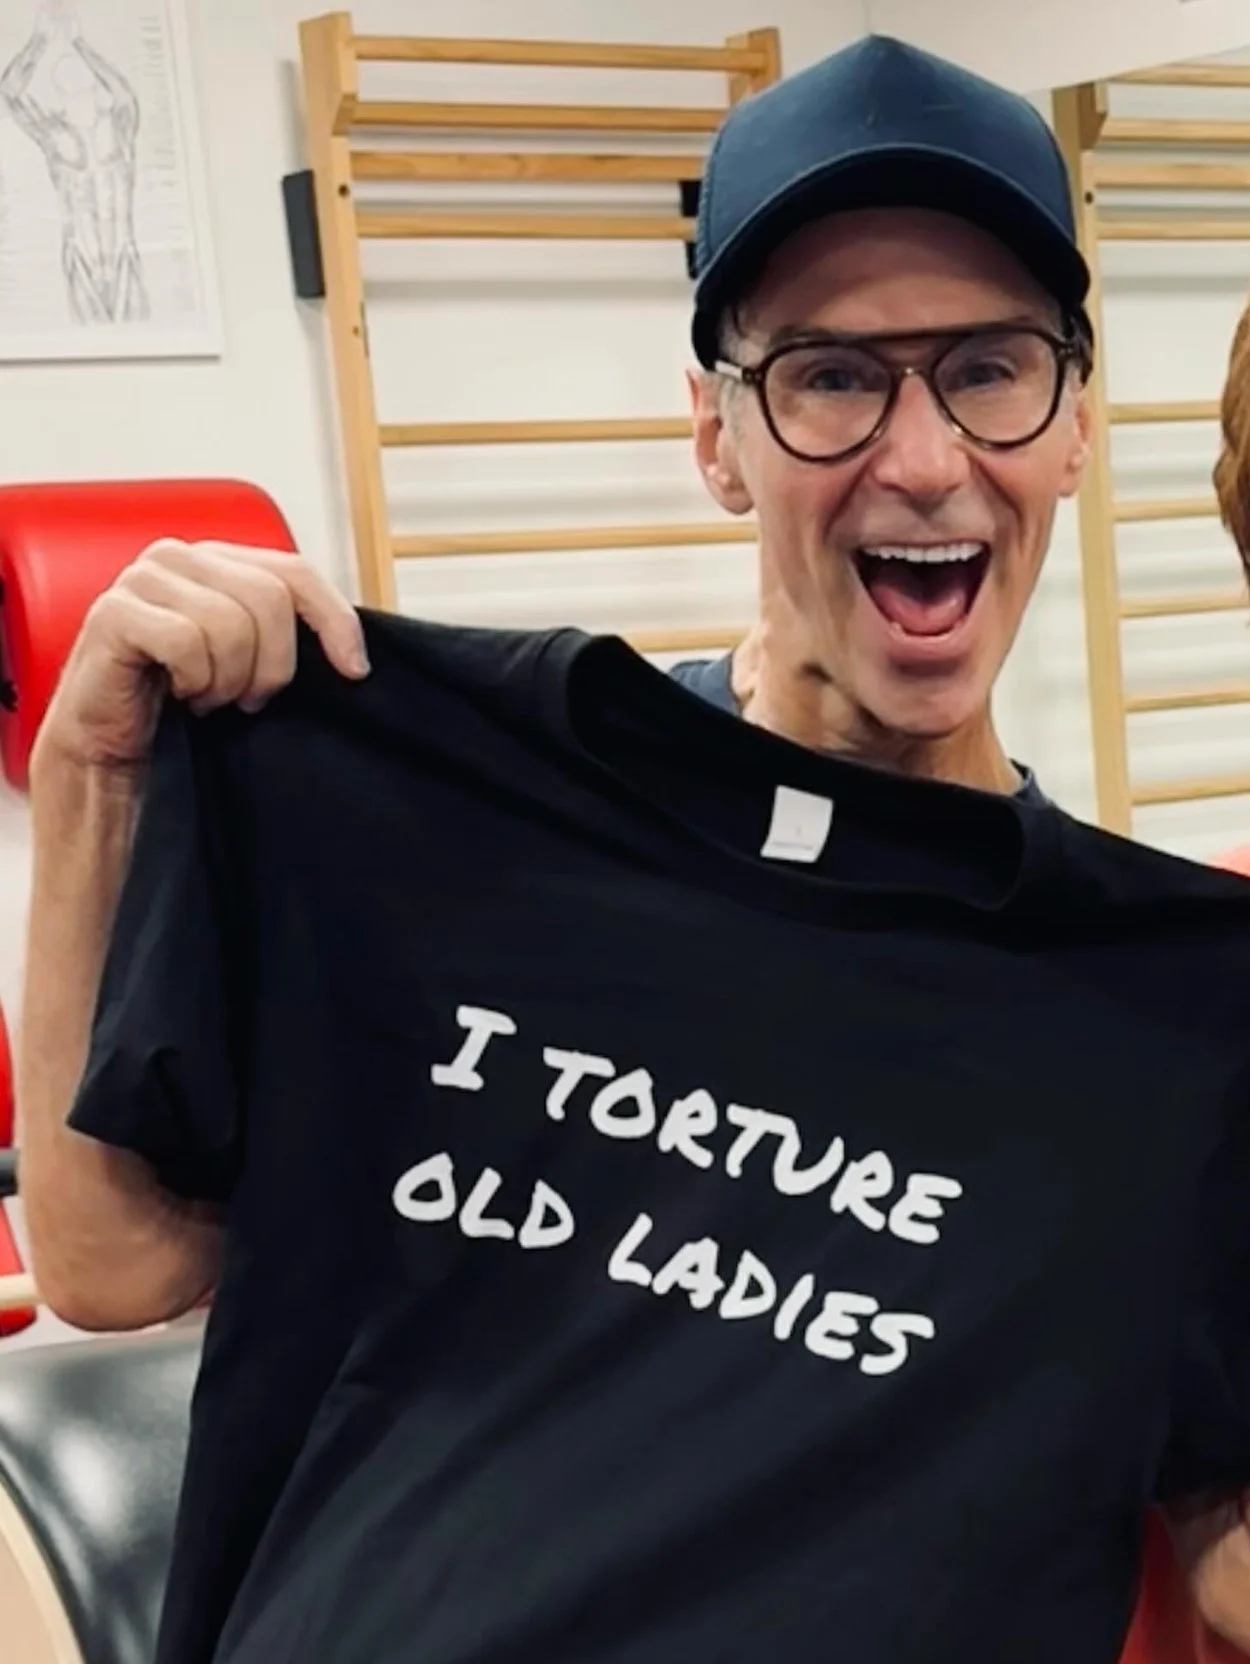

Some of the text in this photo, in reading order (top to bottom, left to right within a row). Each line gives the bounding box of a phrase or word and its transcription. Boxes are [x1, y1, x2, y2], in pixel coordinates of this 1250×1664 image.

[430, 1004, 964, 1245] I TORTURE
[391, 1151, 936, 1376] OLD LADIES
